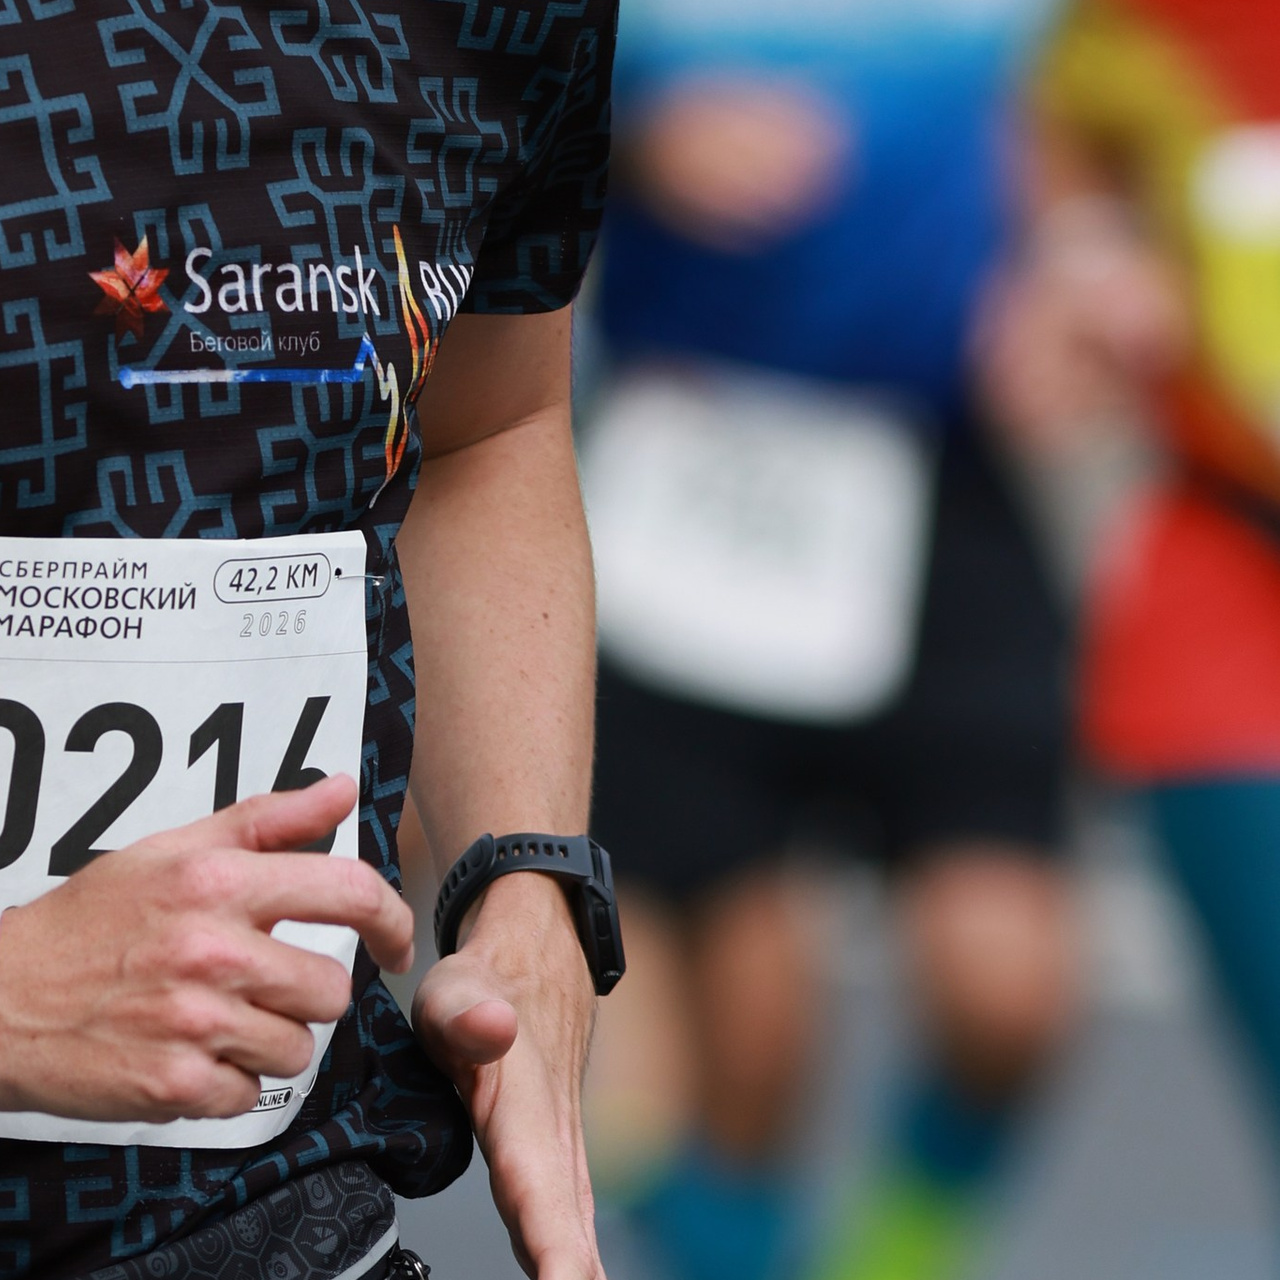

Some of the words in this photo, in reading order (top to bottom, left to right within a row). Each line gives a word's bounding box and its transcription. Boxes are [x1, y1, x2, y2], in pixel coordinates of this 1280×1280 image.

[183, 244, 381, 316] Saransk
[190, 330, 272, 353] Беговой
[278, 330, 321, 357] клуб
[228, 565, 278, 595] 42,2
[286, 562, 319, 590] КМ
[239, 609, 307, 638] 2026
[255, 1092, 285, 1108] NLINE
